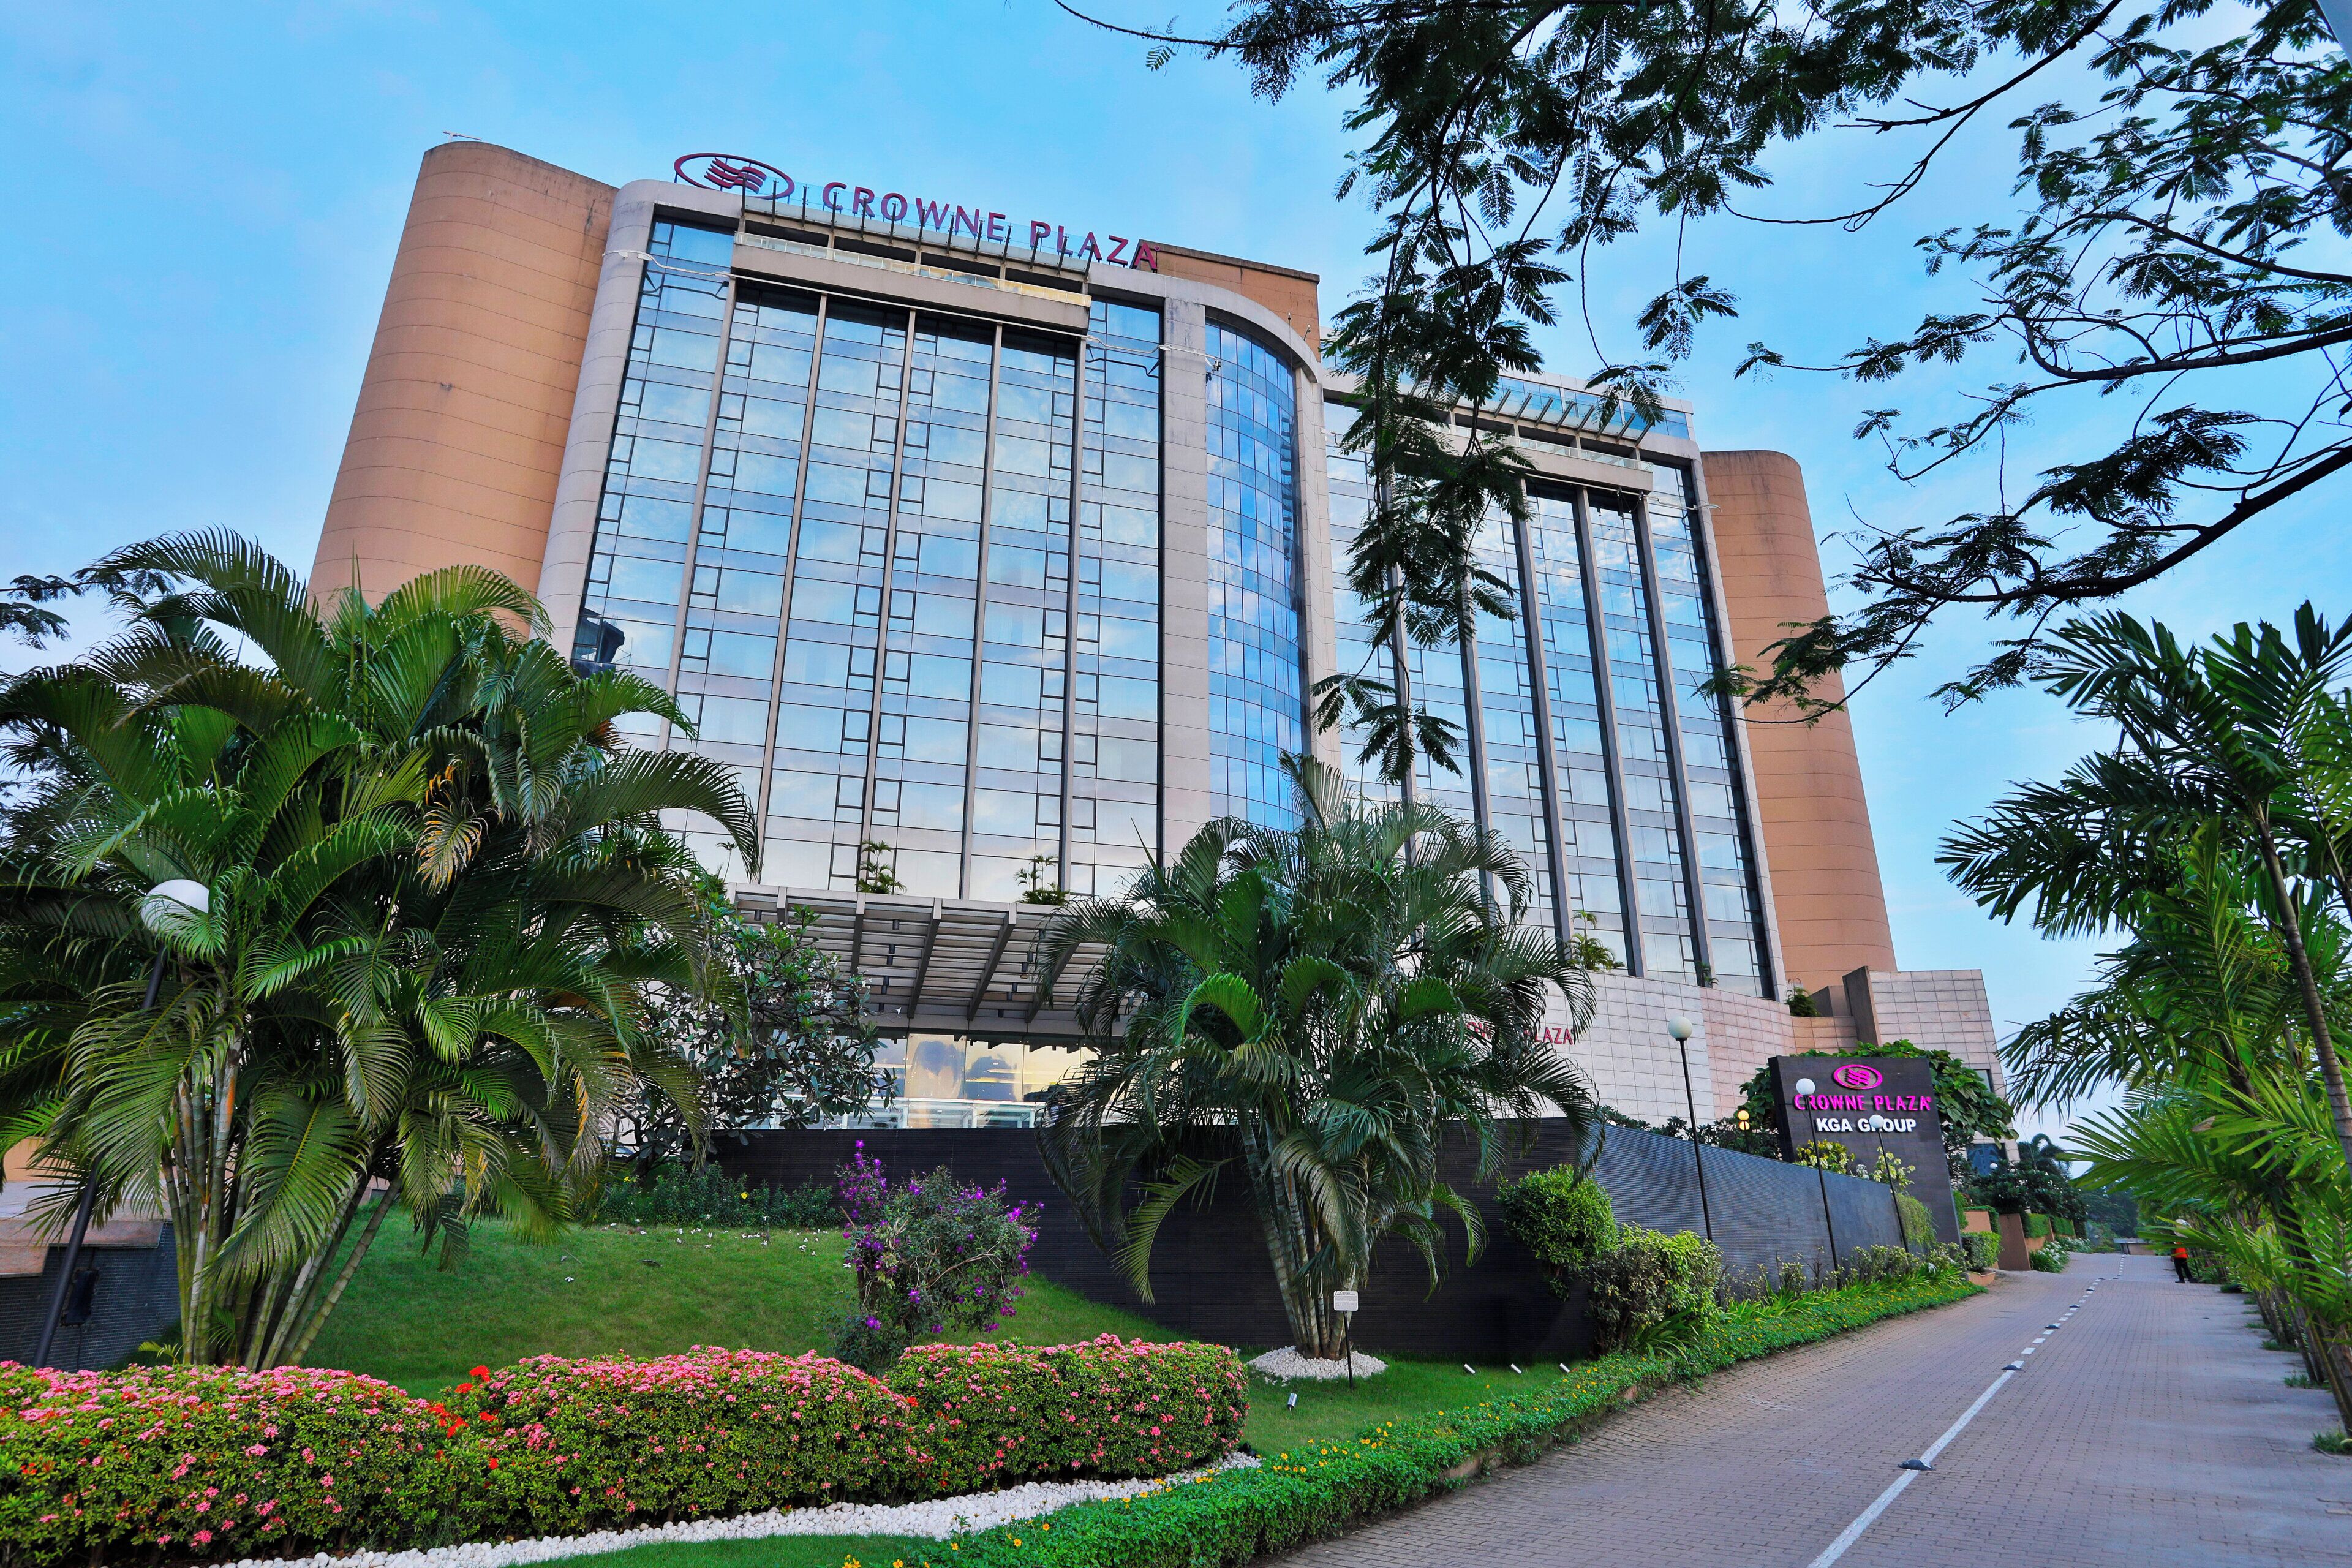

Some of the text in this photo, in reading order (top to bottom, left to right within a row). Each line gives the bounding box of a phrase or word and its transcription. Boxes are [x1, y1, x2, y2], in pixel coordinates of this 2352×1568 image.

[822, 182, 1158, 270] CROWNE PLAZA
[1794, 1094, 1931, 1111] CROWNE PLAZA
[1816, 1118, 1917, 1133] KGA GOUP
